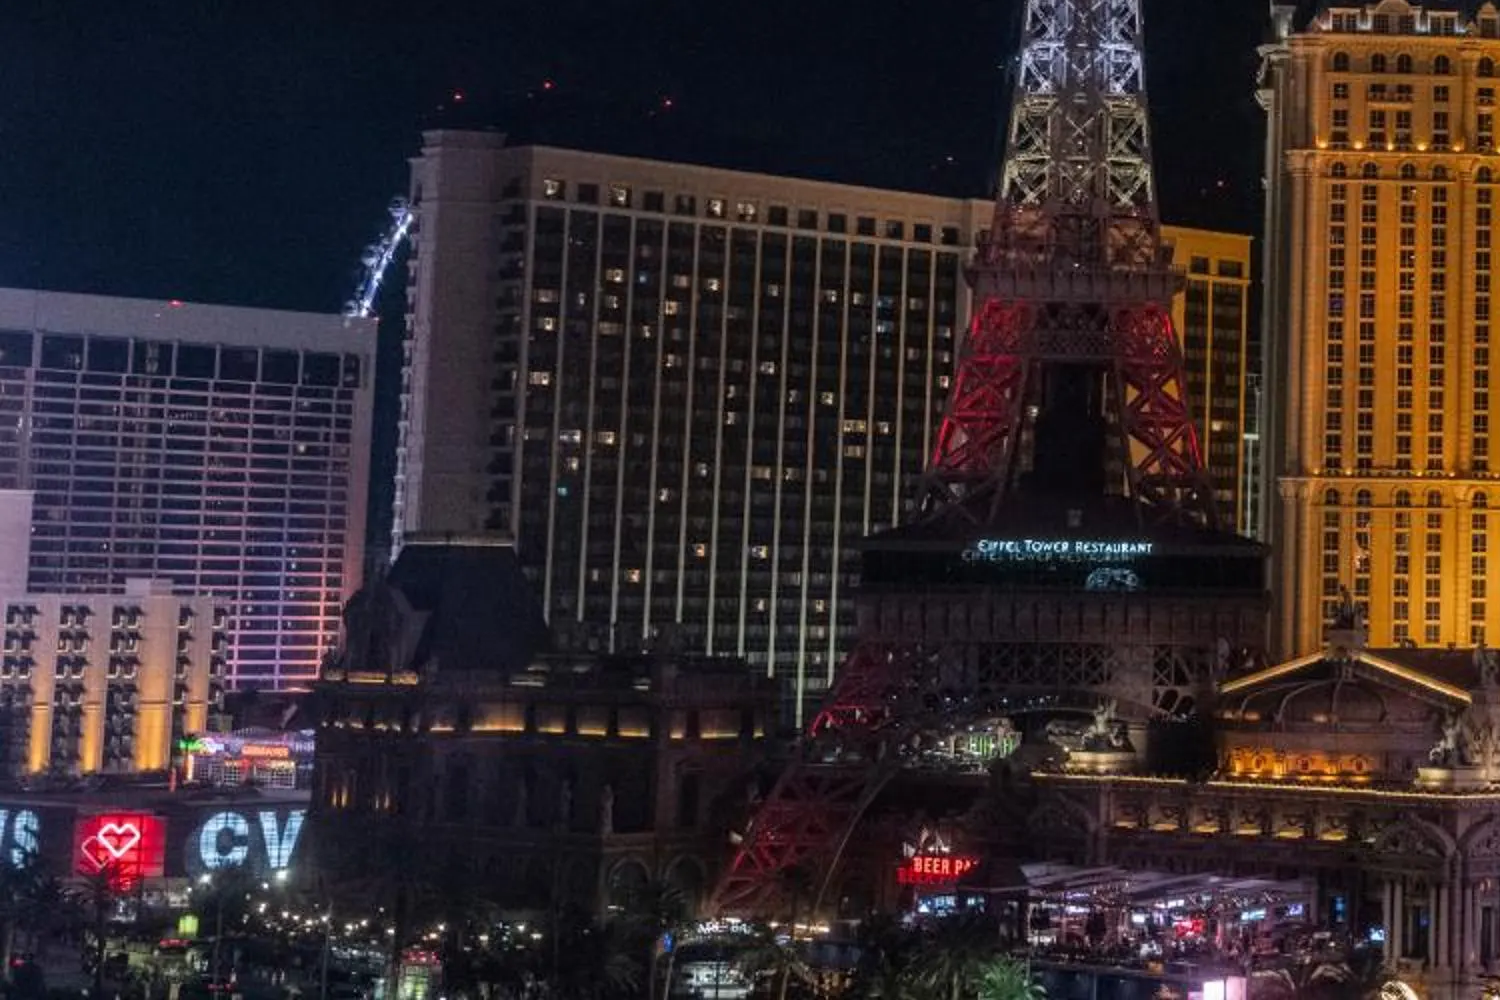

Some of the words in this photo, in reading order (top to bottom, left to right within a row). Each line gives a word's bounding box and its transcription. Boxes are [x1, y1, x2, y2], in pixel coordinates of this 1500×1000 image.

[1024, 539, 1069, 553] TOWER
[1075, 541, 1153, 553] RESTAURANT
[913, 857, 949, 874] BEER
